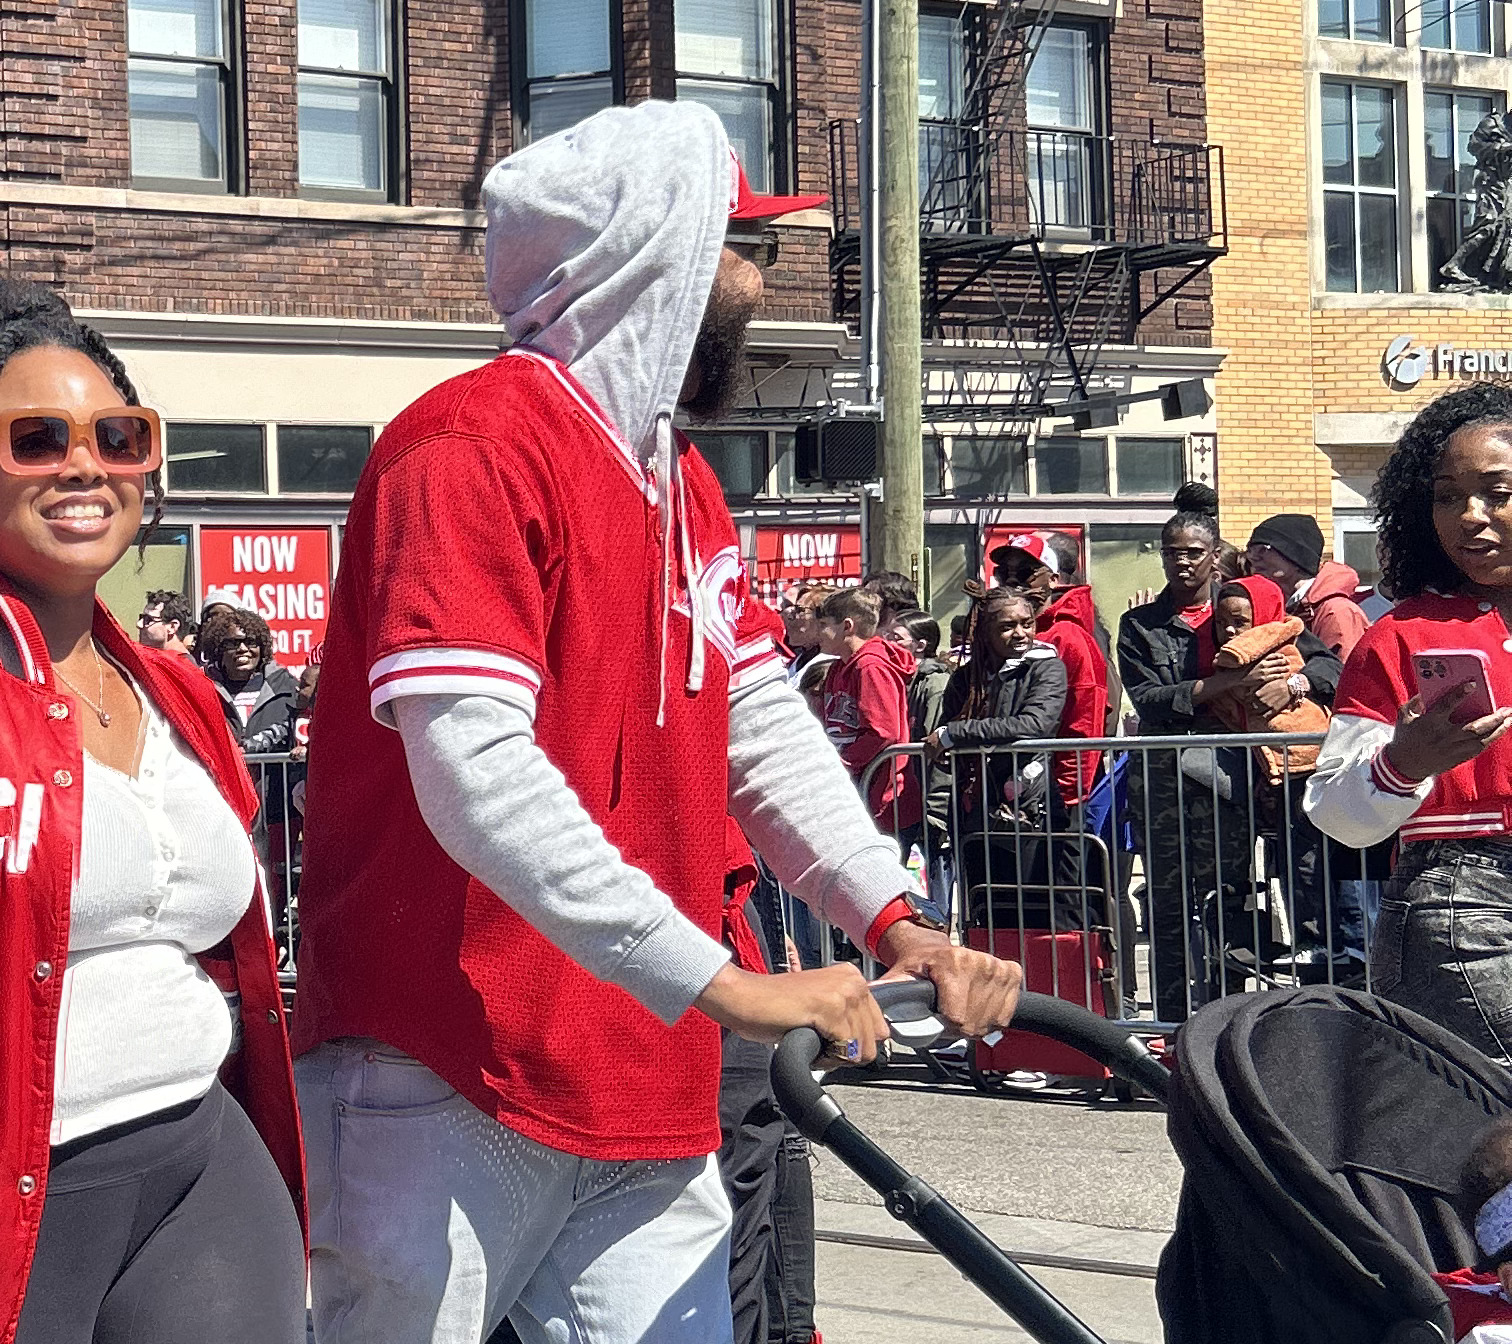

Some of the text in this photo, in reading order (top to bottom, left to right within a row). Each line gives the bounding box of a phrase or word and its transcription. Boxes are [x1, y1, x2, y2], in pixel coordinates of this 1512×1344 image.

[231, 535, 297, 573] NOW
[783, 533, 837, 567] NOW
[207, 583, 325, 621] ASING
[293, 629, 312, 653] FT
